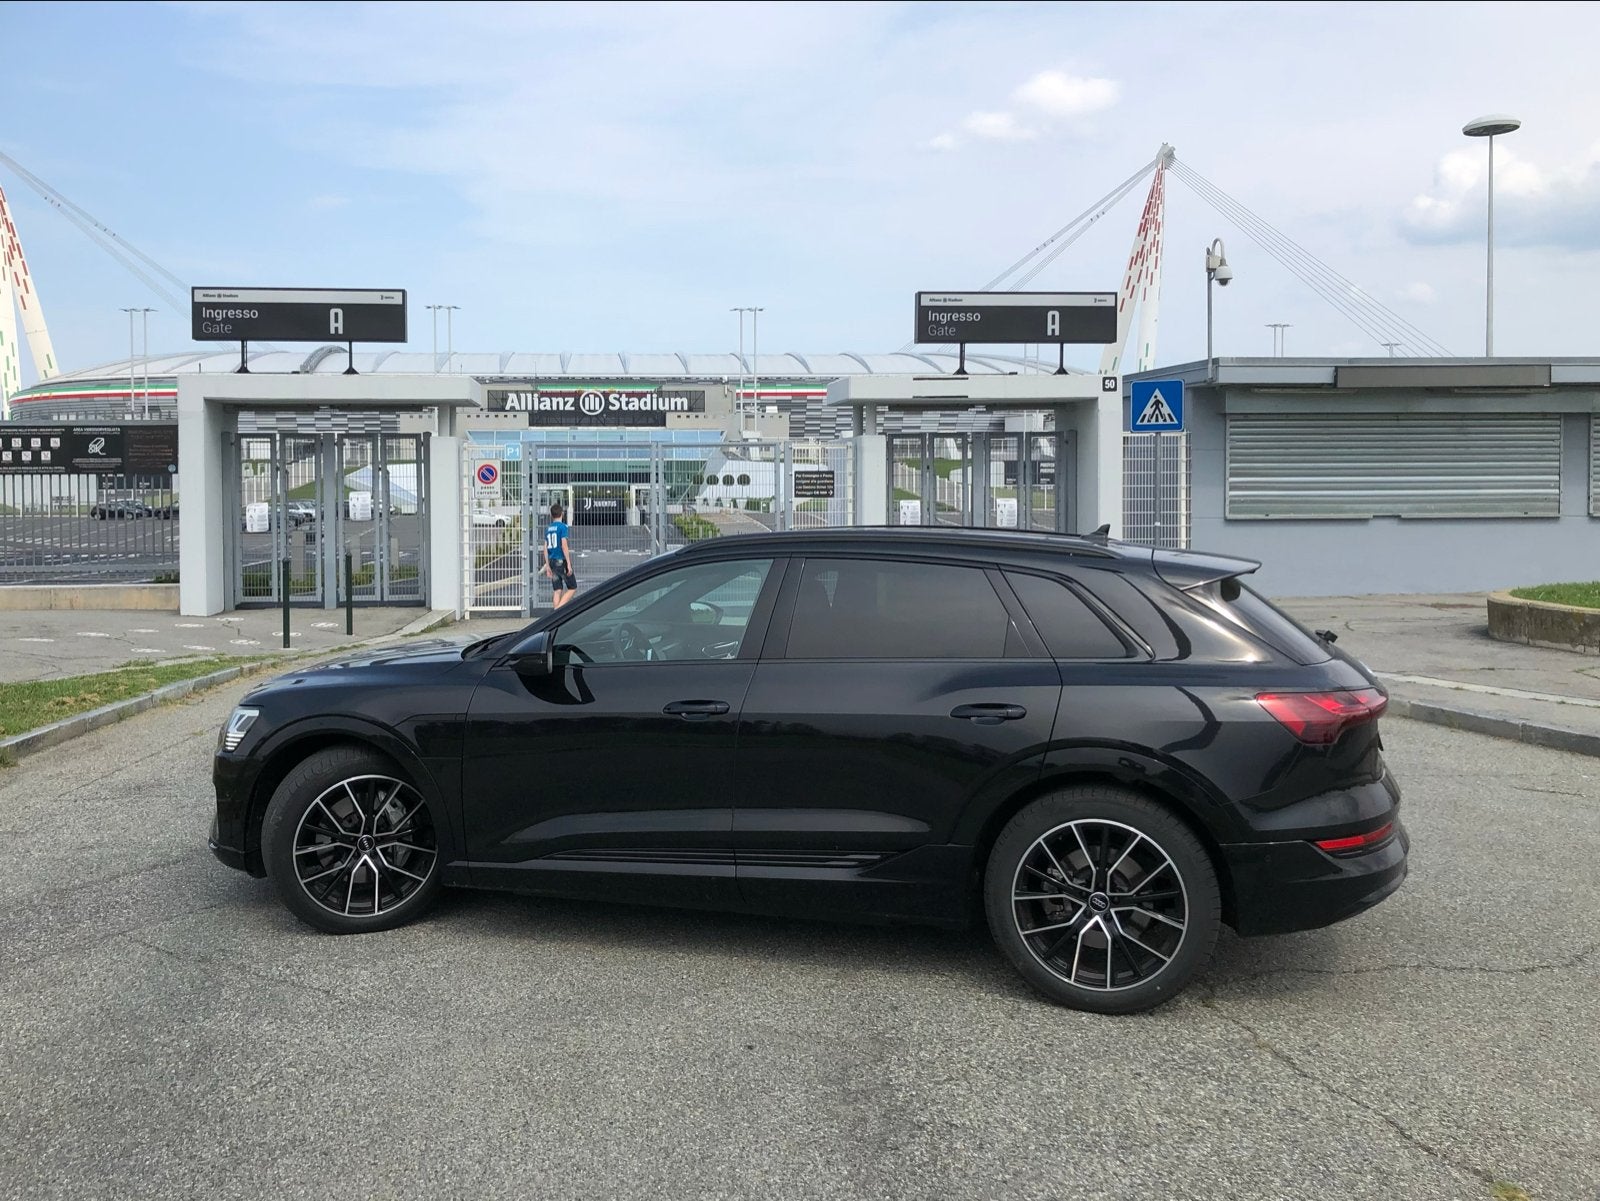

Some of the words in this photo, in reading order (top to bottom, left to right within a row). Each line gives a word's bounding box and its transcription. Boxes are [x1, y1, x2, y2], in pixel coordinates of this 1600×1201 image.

[202, 307, 259, 321] Ingresso
[329, 308, 343, 334] A
[928, 310, 981, 324] Ingresso
[1047, 310, 1060, 336] A
[202, 322, 232, 334] Gate
[928, 325, 956, 336] Gate
[1104, 379, 1115, 389] 50
[505, 392, 575, 411] Allianz
[608, 393, 688, 411] Stadium
[507, 447, 519, 456] P1
[546, 532, 558, 549] 10
